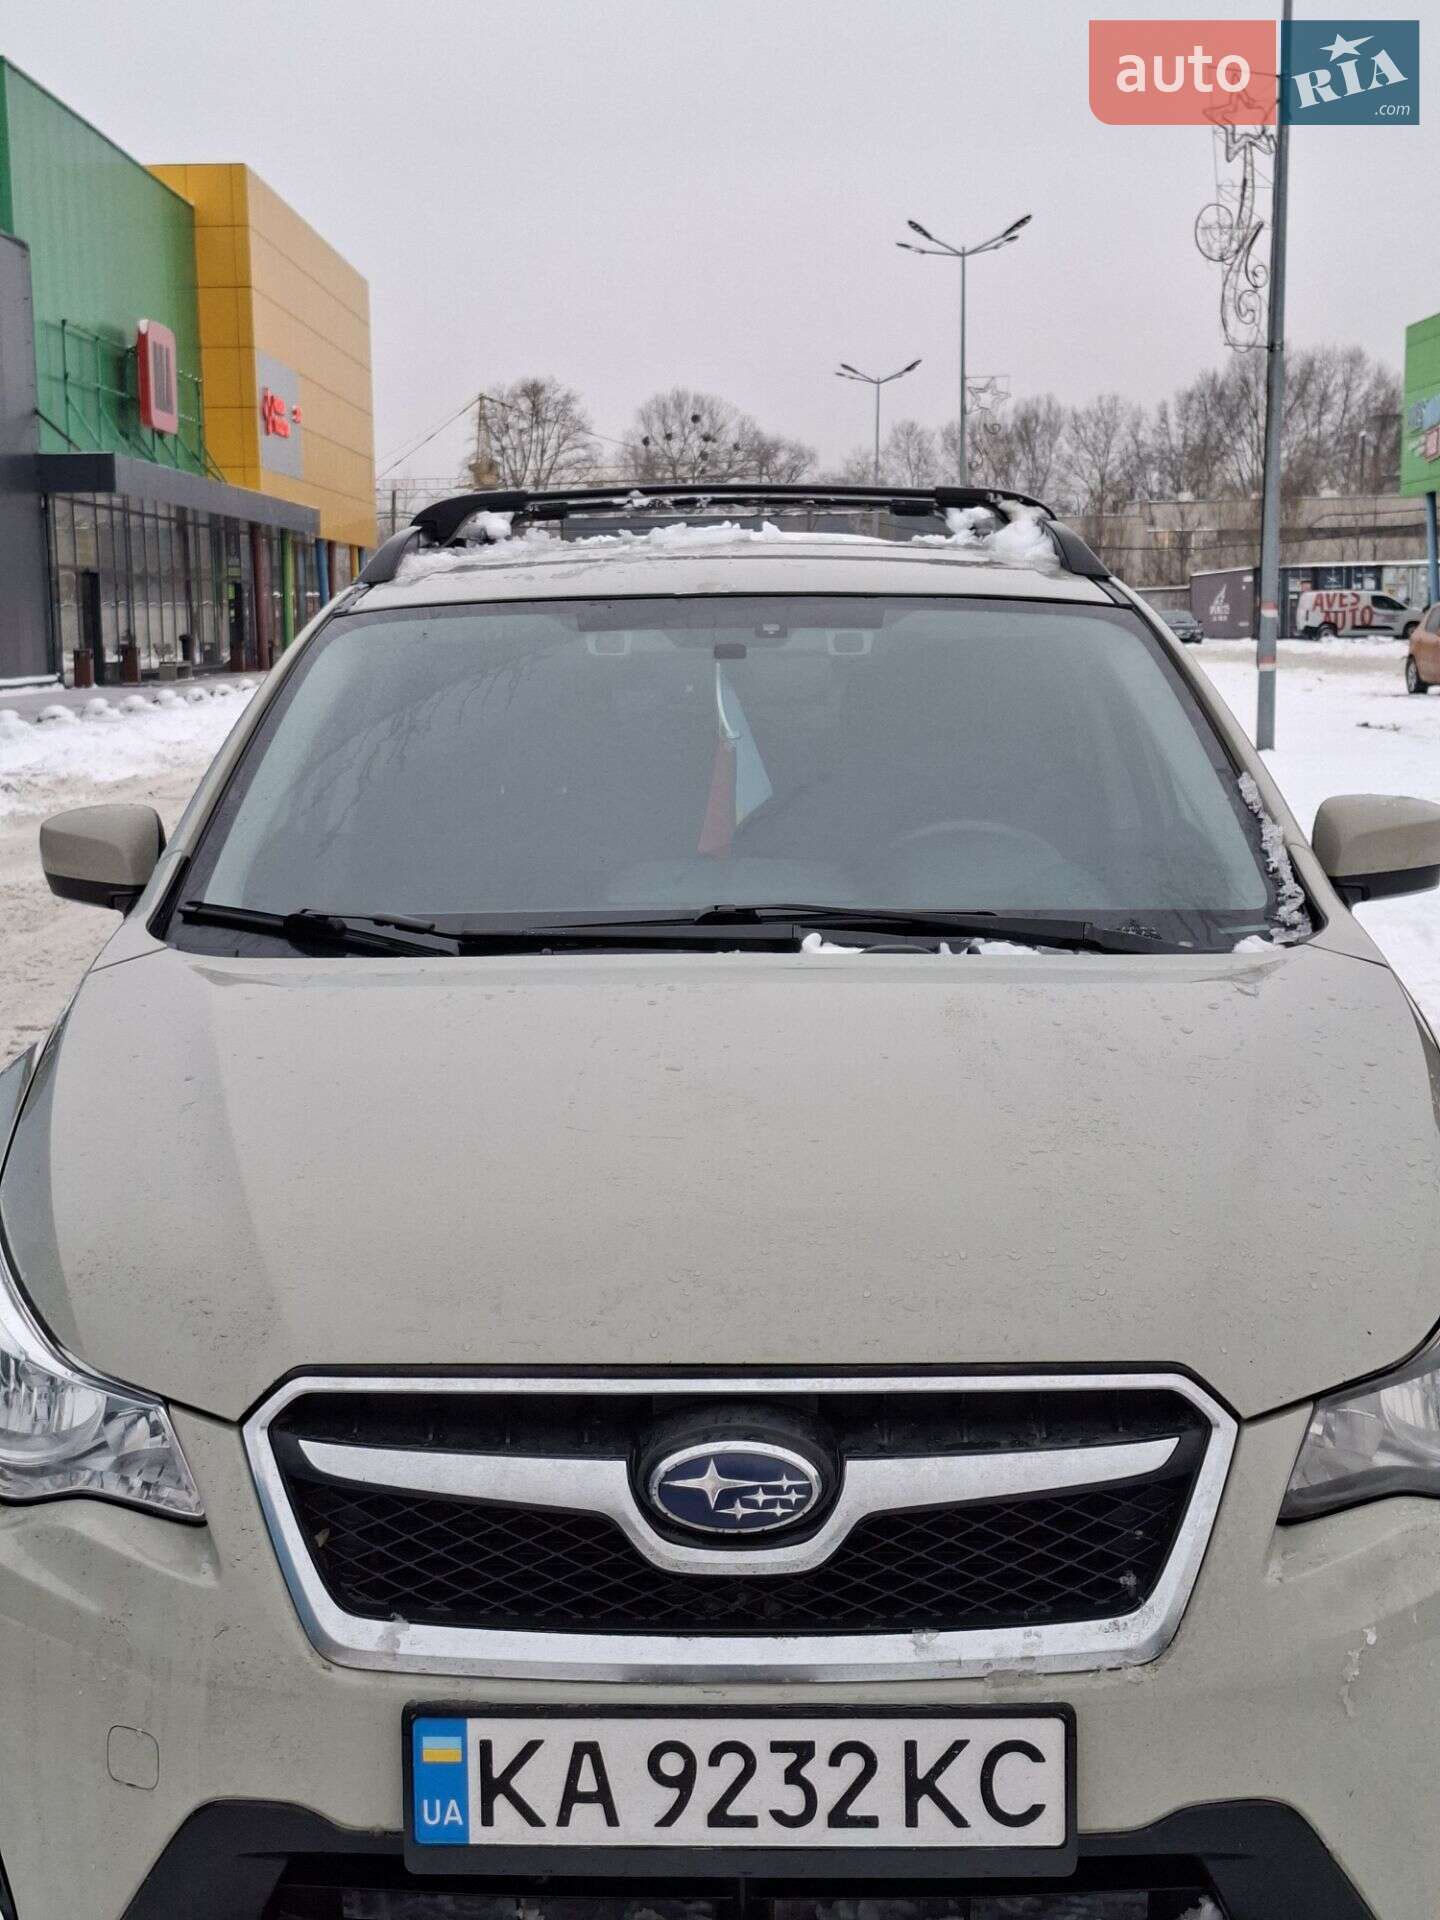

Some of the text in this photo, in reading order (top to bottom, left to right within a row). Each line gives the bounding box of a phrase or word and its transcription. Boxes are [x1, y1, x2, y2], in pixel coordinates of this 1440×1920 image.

[1312, 591, 1361, 612] AVES
[1323, 605, 1374, 631] AUTO
[479, 1739, 1047, 1828] KA 9232 KC
[423, 1799, 464, 1826] UA
